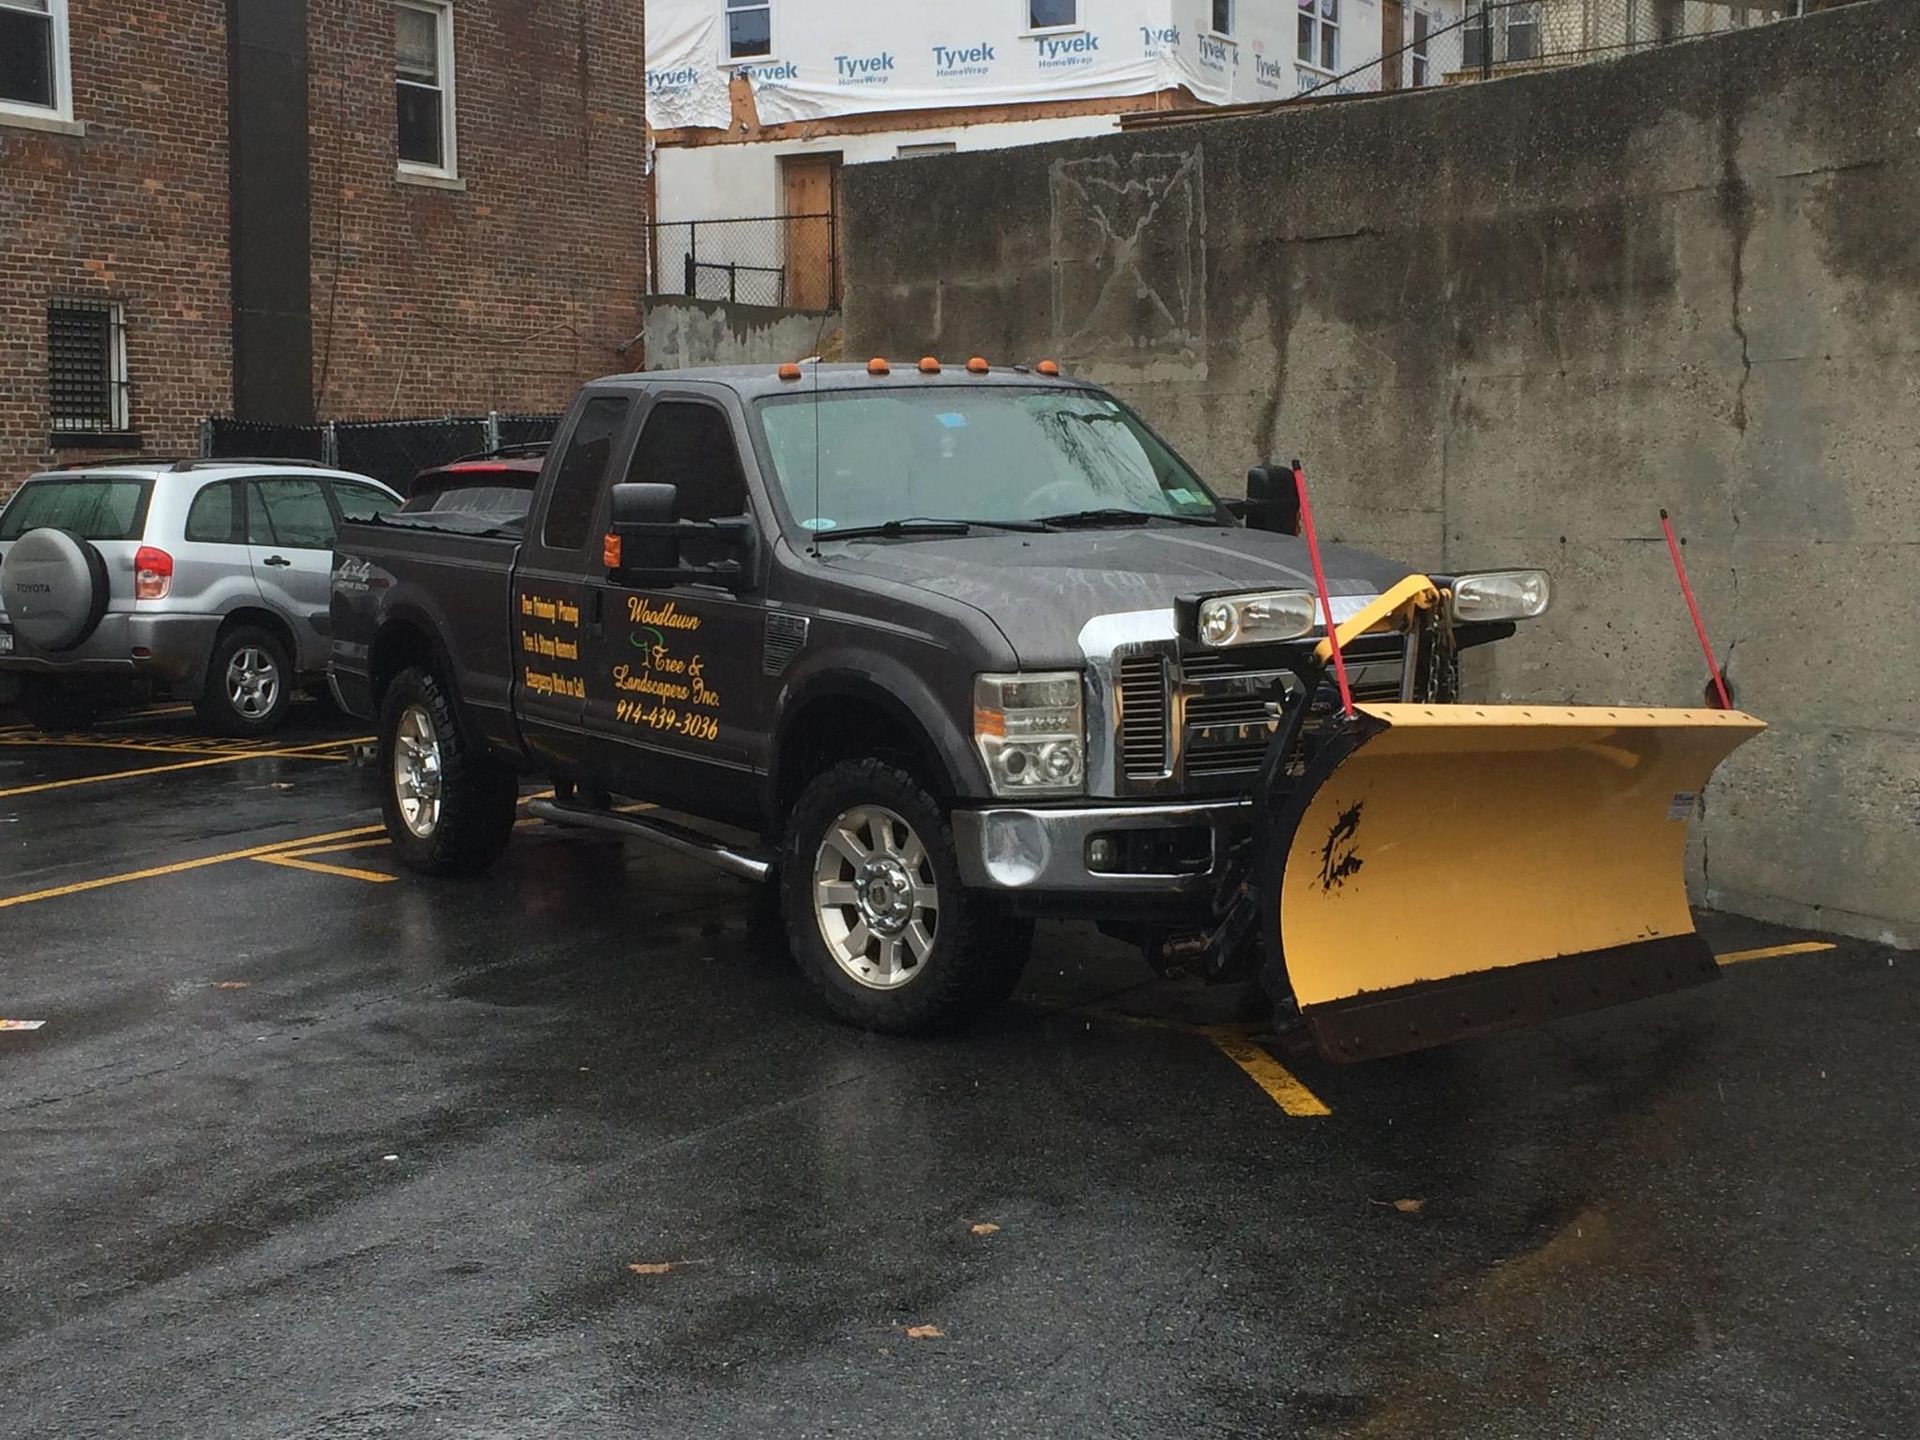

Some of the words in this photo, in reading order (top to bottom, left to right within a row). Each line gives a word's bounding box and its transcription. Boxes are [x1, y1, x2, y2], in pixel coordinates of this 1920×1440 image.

[932, 42, 995, 68] Tyvek
[1034, 32, 1099, 59] Tyvek
[1198, 33, 1226, 61] Tyvek
[835, 52, 894, 78] Tyvek
[937, 66, 989, 78] HomeWrap
[1038, 57, 1092, 68] HomeWrap
[1255, 54, 1281, 79] Tyvek
[645, 67, 698, 91] Tyvek
[839, 75, 888, 86] HomeWrap
[16, 583, 51, 593] TOYOTA
[628, 596, 702, 630] Woodlawn
[652, 645, 686, 673] Tree
[688, 654, 705, 676] &
[613, 664, 690, 705] Landscapers
[692, 677, 720, 707] Inc.
[616, 699, 719, 741] 914-439-3036
